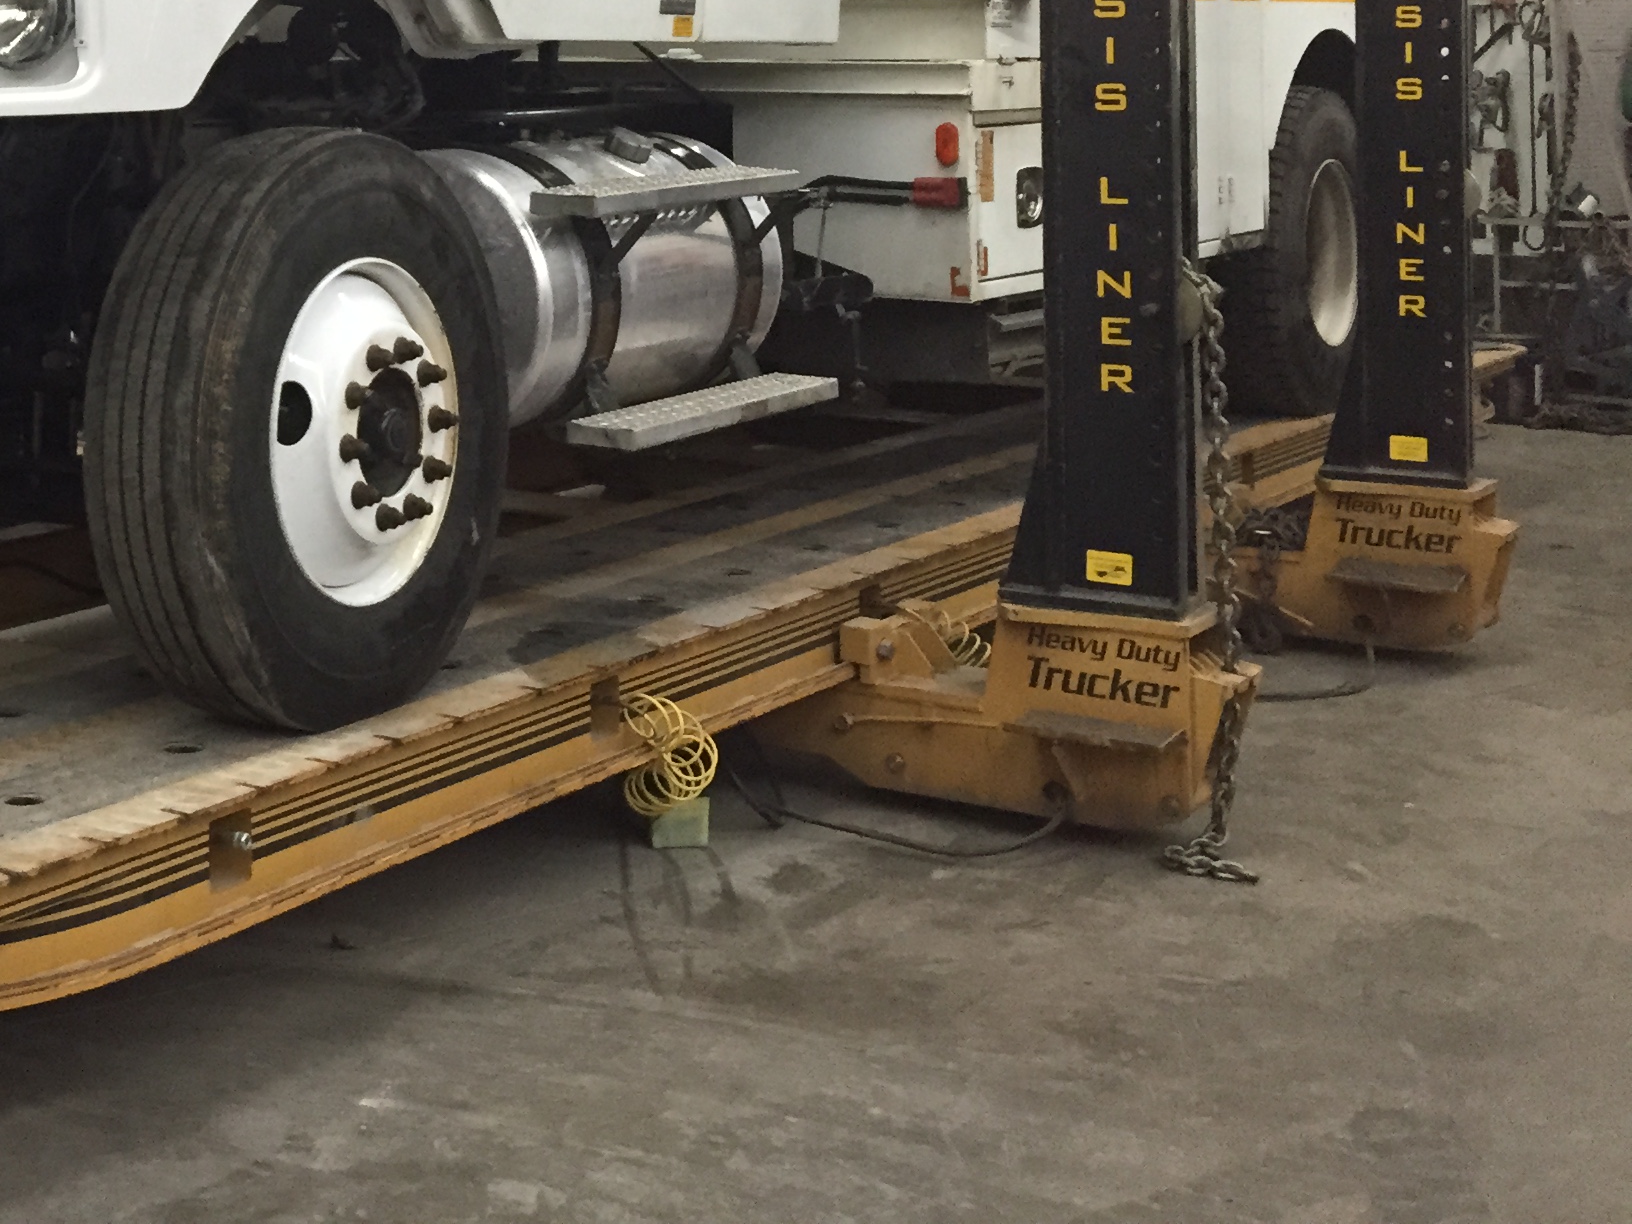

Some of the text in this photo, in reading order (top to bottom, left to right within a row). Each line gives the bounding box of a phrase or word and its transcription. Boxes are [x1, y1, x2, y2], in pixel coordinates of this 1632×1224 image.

[1396, 151, 1426, 318] LINER
[1096, 176, 1133, 393] LINER
[1336, 493, 1462, 526] Heavy Duty
[1336, 518, 1463, 554] Trucker
[1027, 626, 1181, 672] Heavy Duty
[1027, 655, 1181, 708] Trucker
